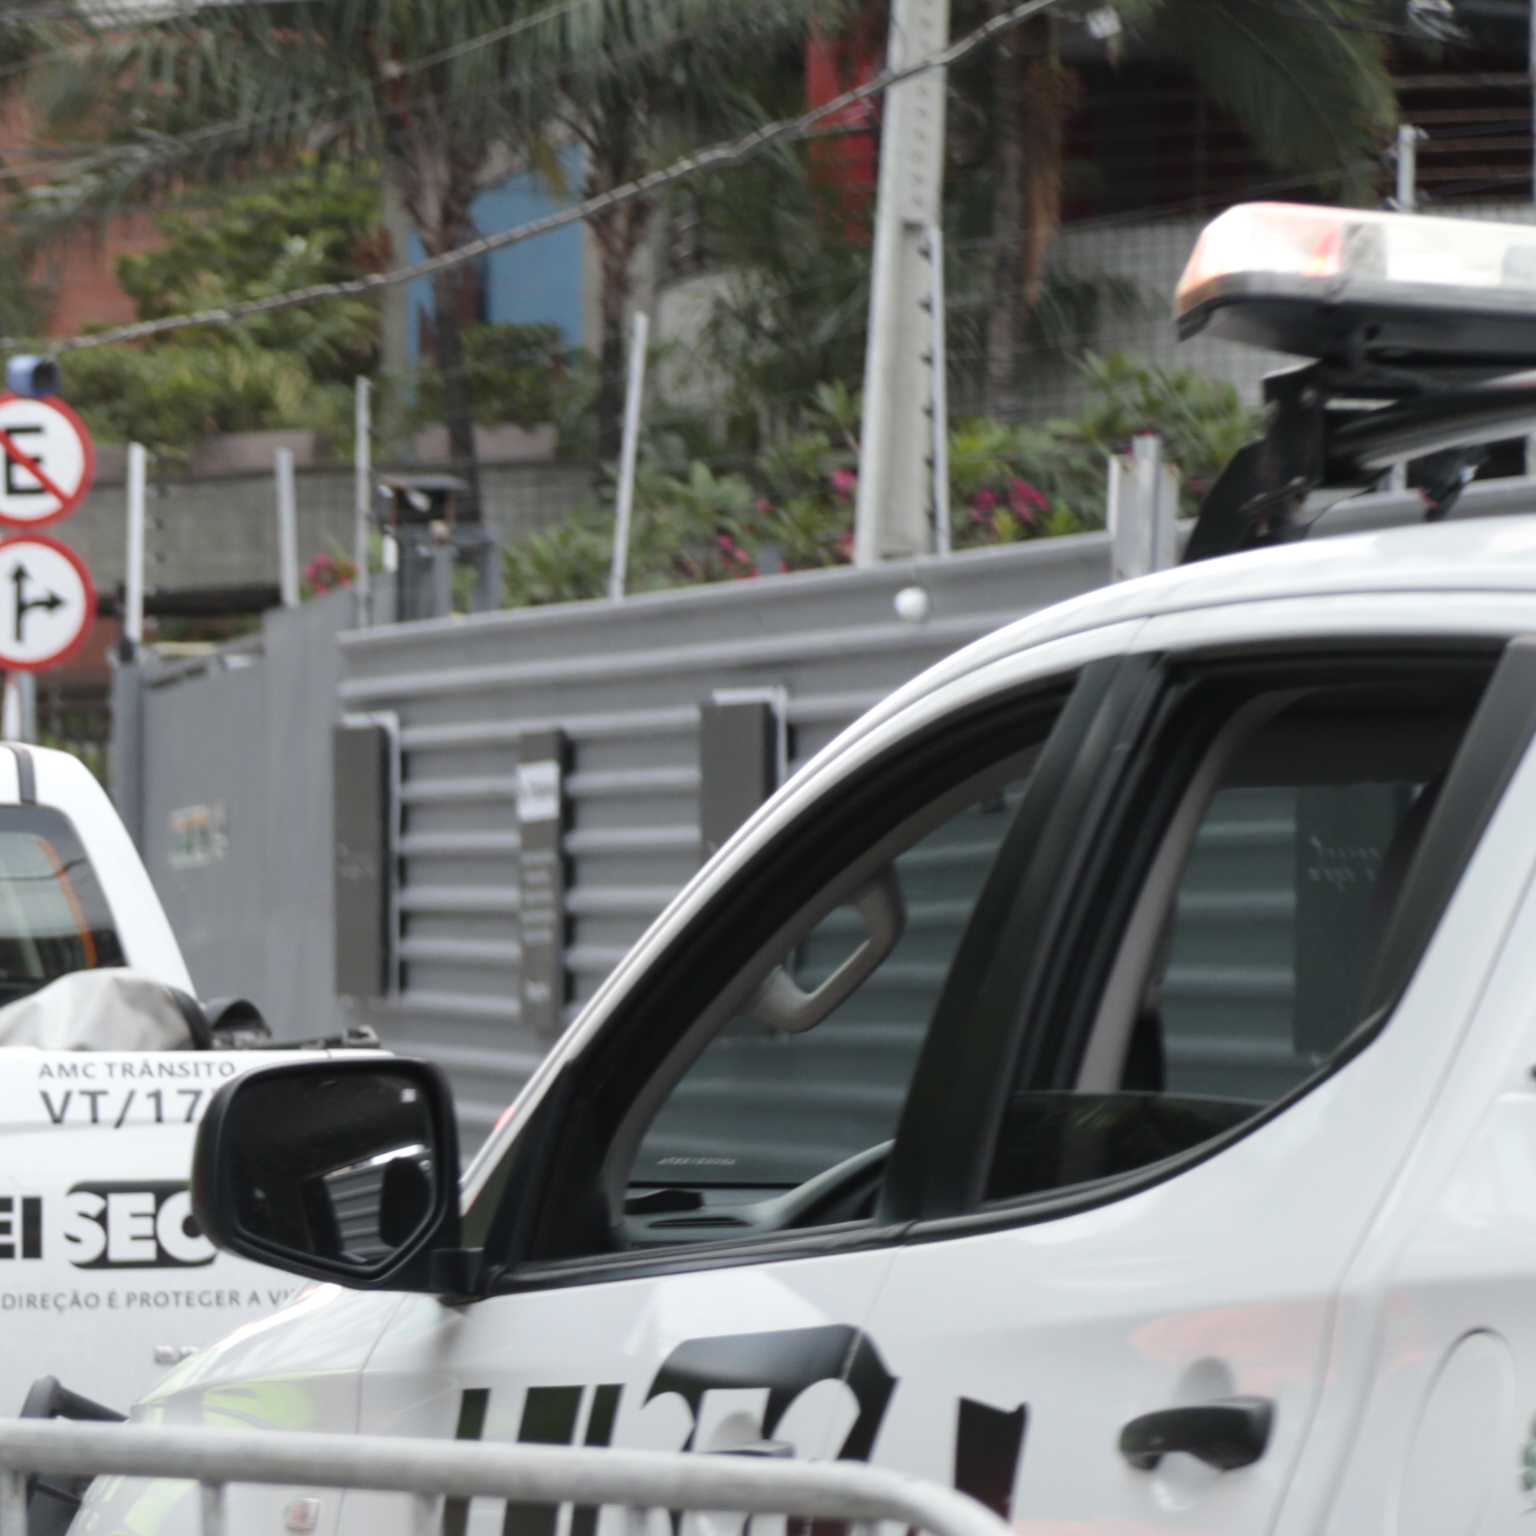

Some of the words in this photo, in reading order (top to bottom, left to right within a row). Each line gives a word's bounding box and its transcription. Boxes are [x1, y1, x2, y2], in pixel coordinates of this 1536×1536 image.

[38, 1062, 96, 1078] AMC
[104, 1059, 235, 1078] TRÂNSITO
[39, 1089, 218, 1128] VT/17
[64, 1190, 220, 1264] SEC
[1, 1290, 101, 1313] DIREÇÃO
[108, 1290, 120, 1309] É
[128, 1289, 241, 1309] PROTEGER
[247, 1289, 262, 1307] A
